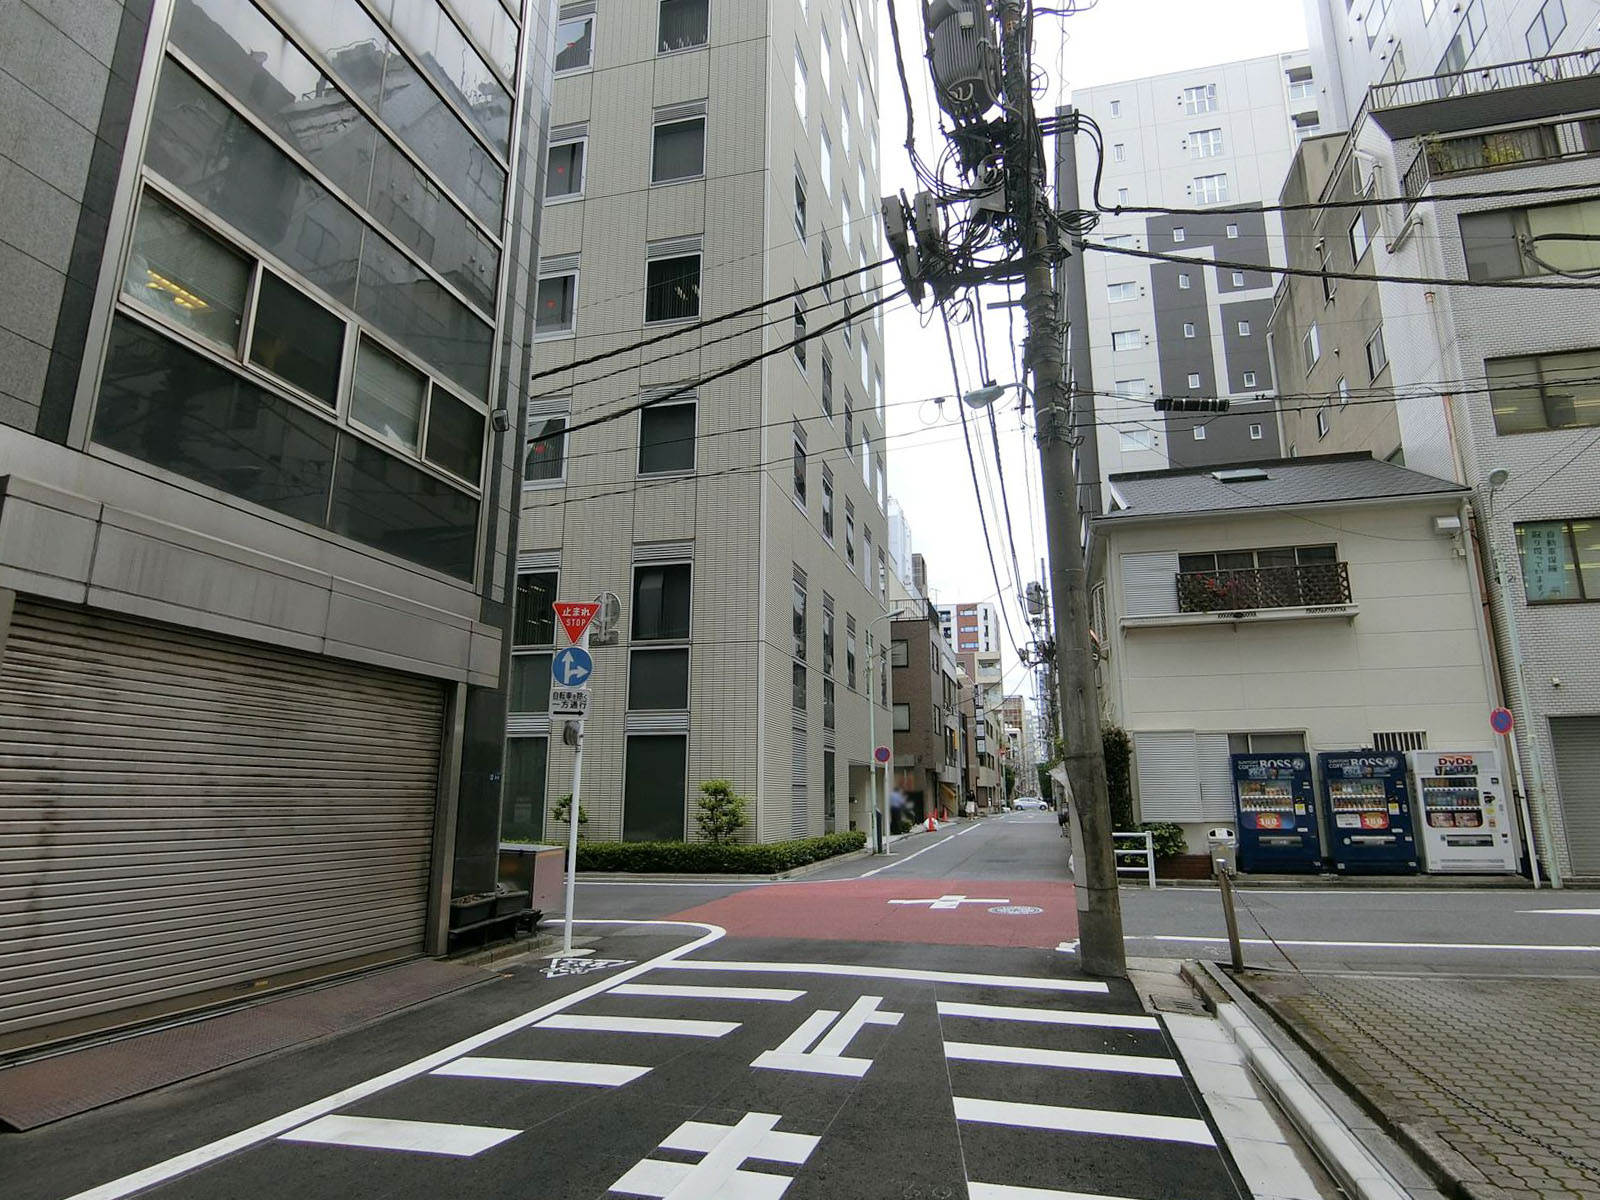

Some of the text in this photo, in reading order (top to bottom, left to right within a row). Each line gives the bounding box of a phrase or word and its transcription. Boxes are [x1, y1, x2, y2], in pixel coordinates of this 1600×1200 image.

[562, 607, 591, 617] 止まれ
[566, 618, 586, 627] STOP
[553, 691, 588, 701] 自転車を除く
[552, 700, 587, 710] 一方通行
[1260, 759, 1292, 768] BOSS
[1351, 758, 1384, 766] BOSS
